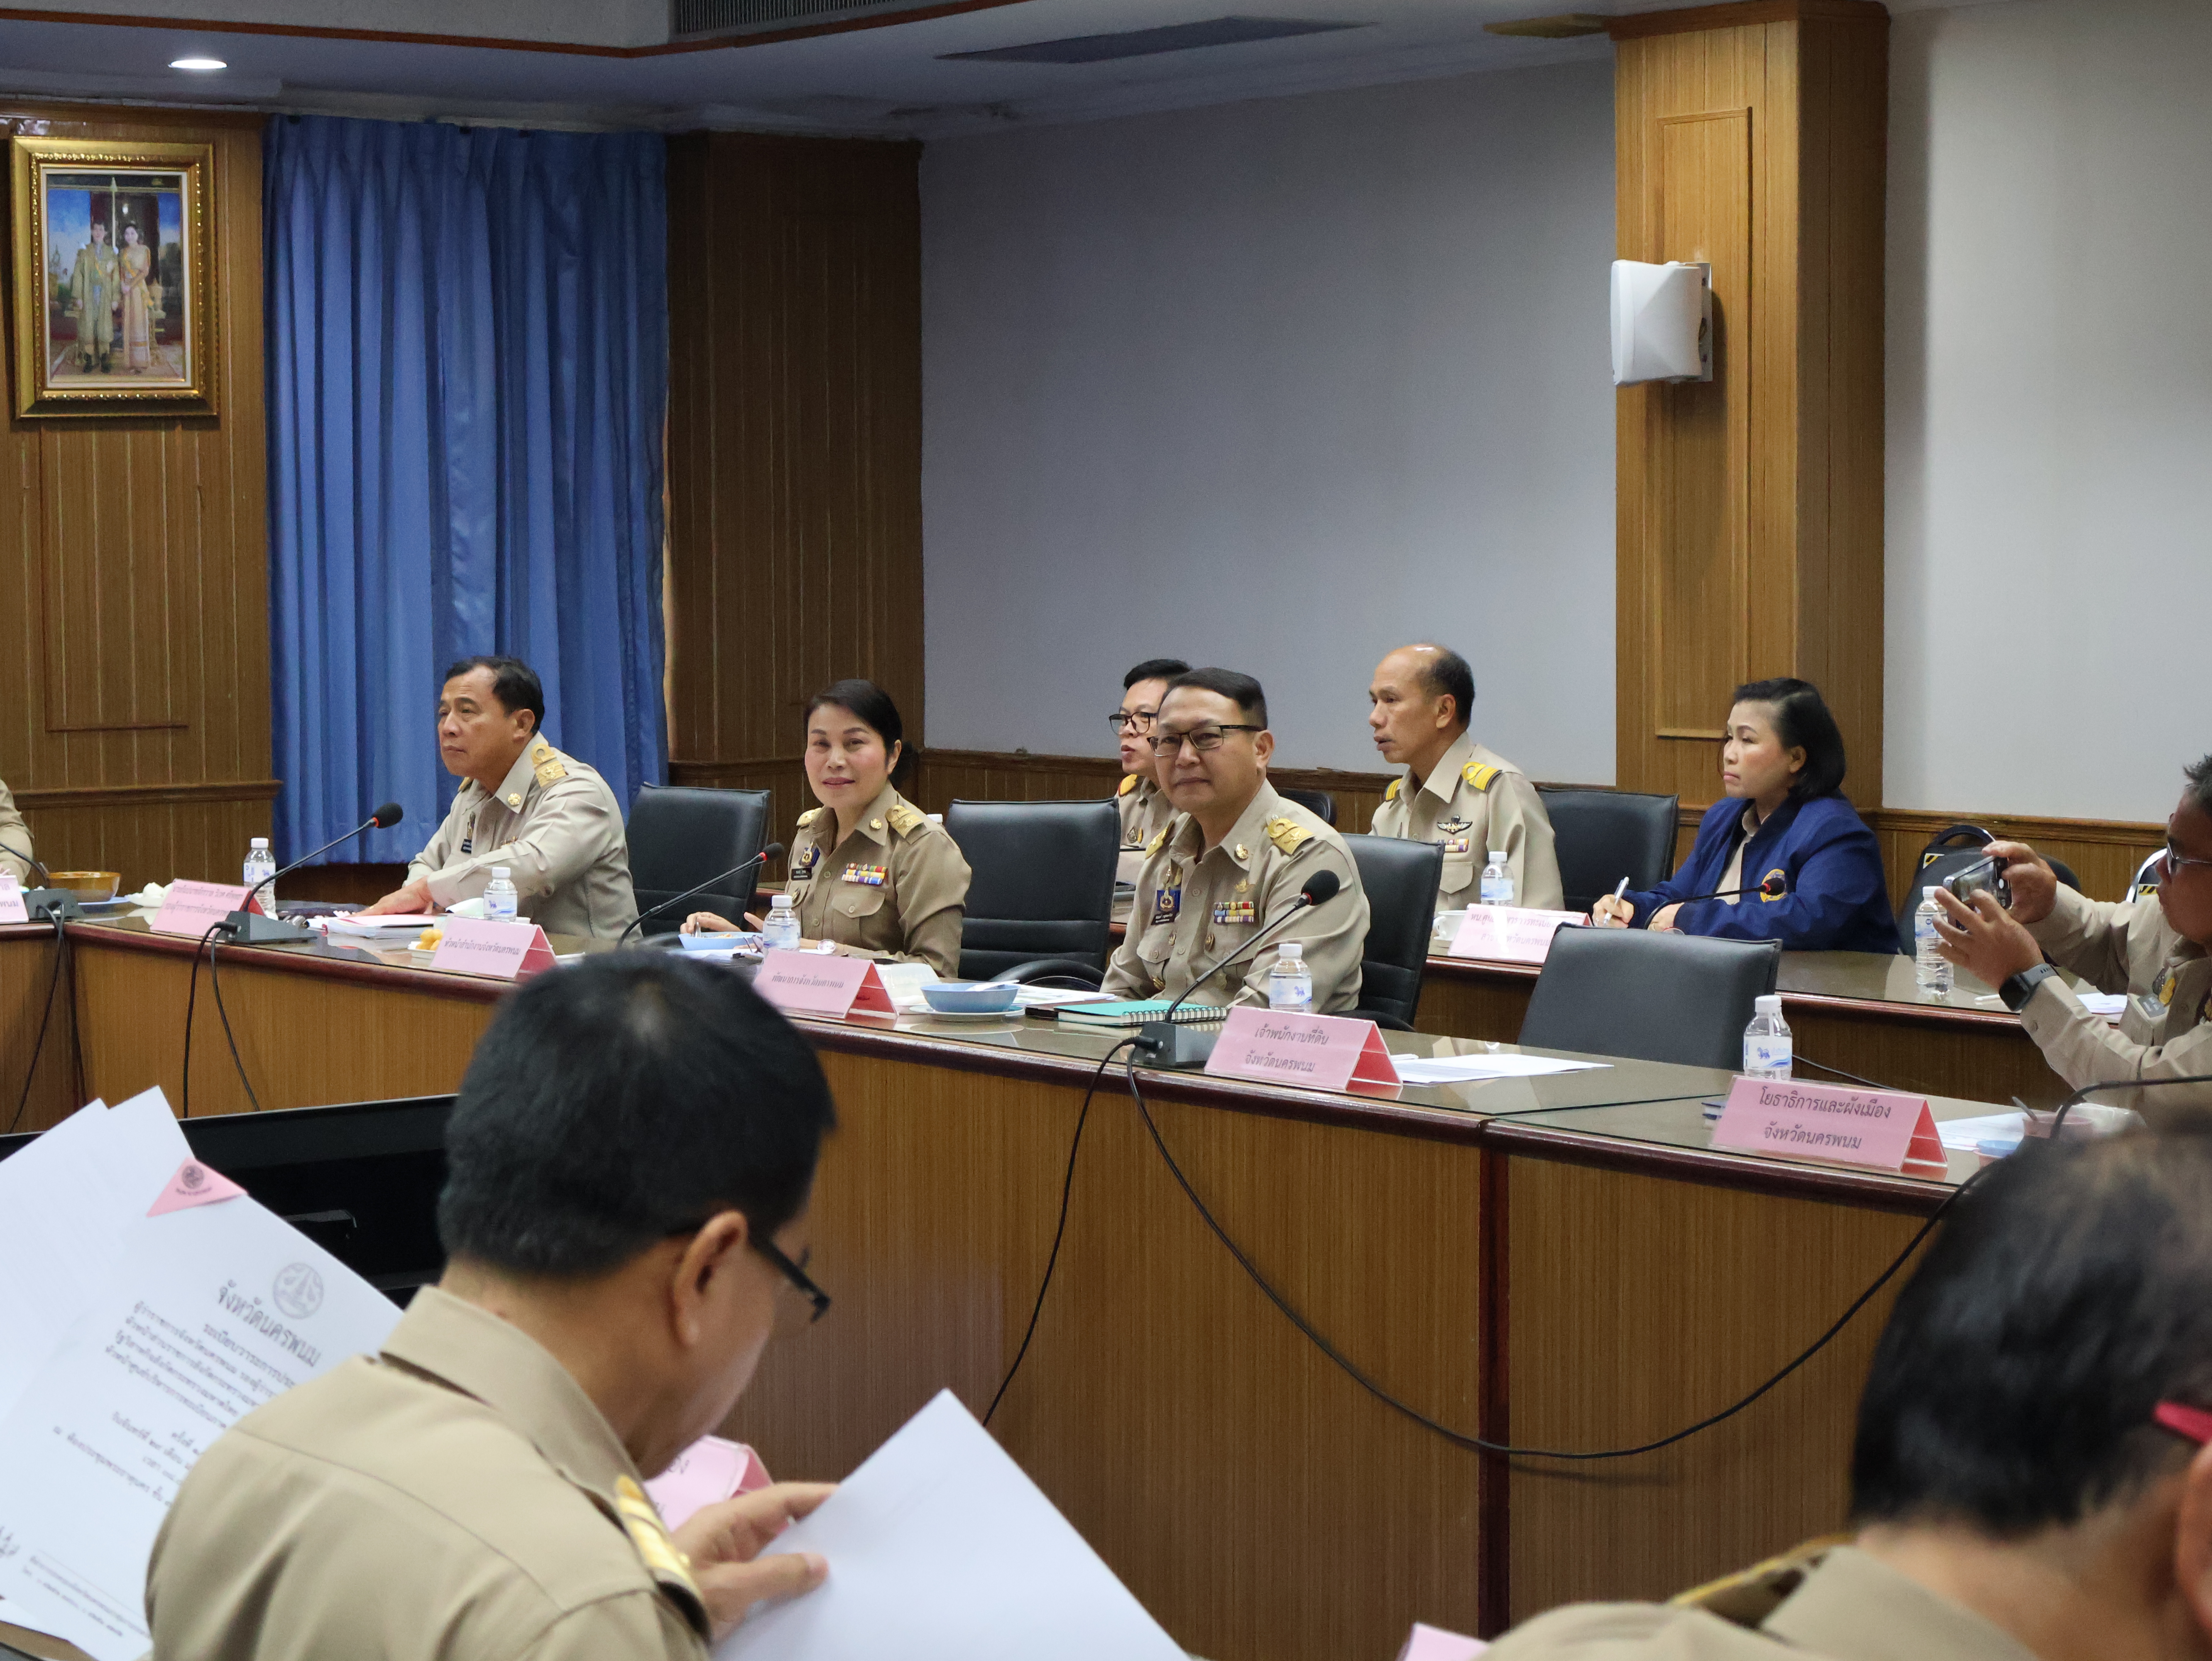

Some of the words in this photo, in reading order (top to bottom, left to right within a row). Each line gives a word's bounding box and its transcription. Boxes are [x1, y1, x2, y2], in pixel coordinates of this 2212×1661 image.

[1255, 1022, 1329, 1046] เจ้าพนักงานที่ดิน
[1245, 1050, 1315, 1072] จังหวัดนครพนม
[1759, 1086, 1891, 1119] โยธาธิการและผังเมือง
[1764, 1122, 1862, 1149] จังหวัดนครพนม
[218, 1279, 321, 1367] จังหวัดนครพนม
